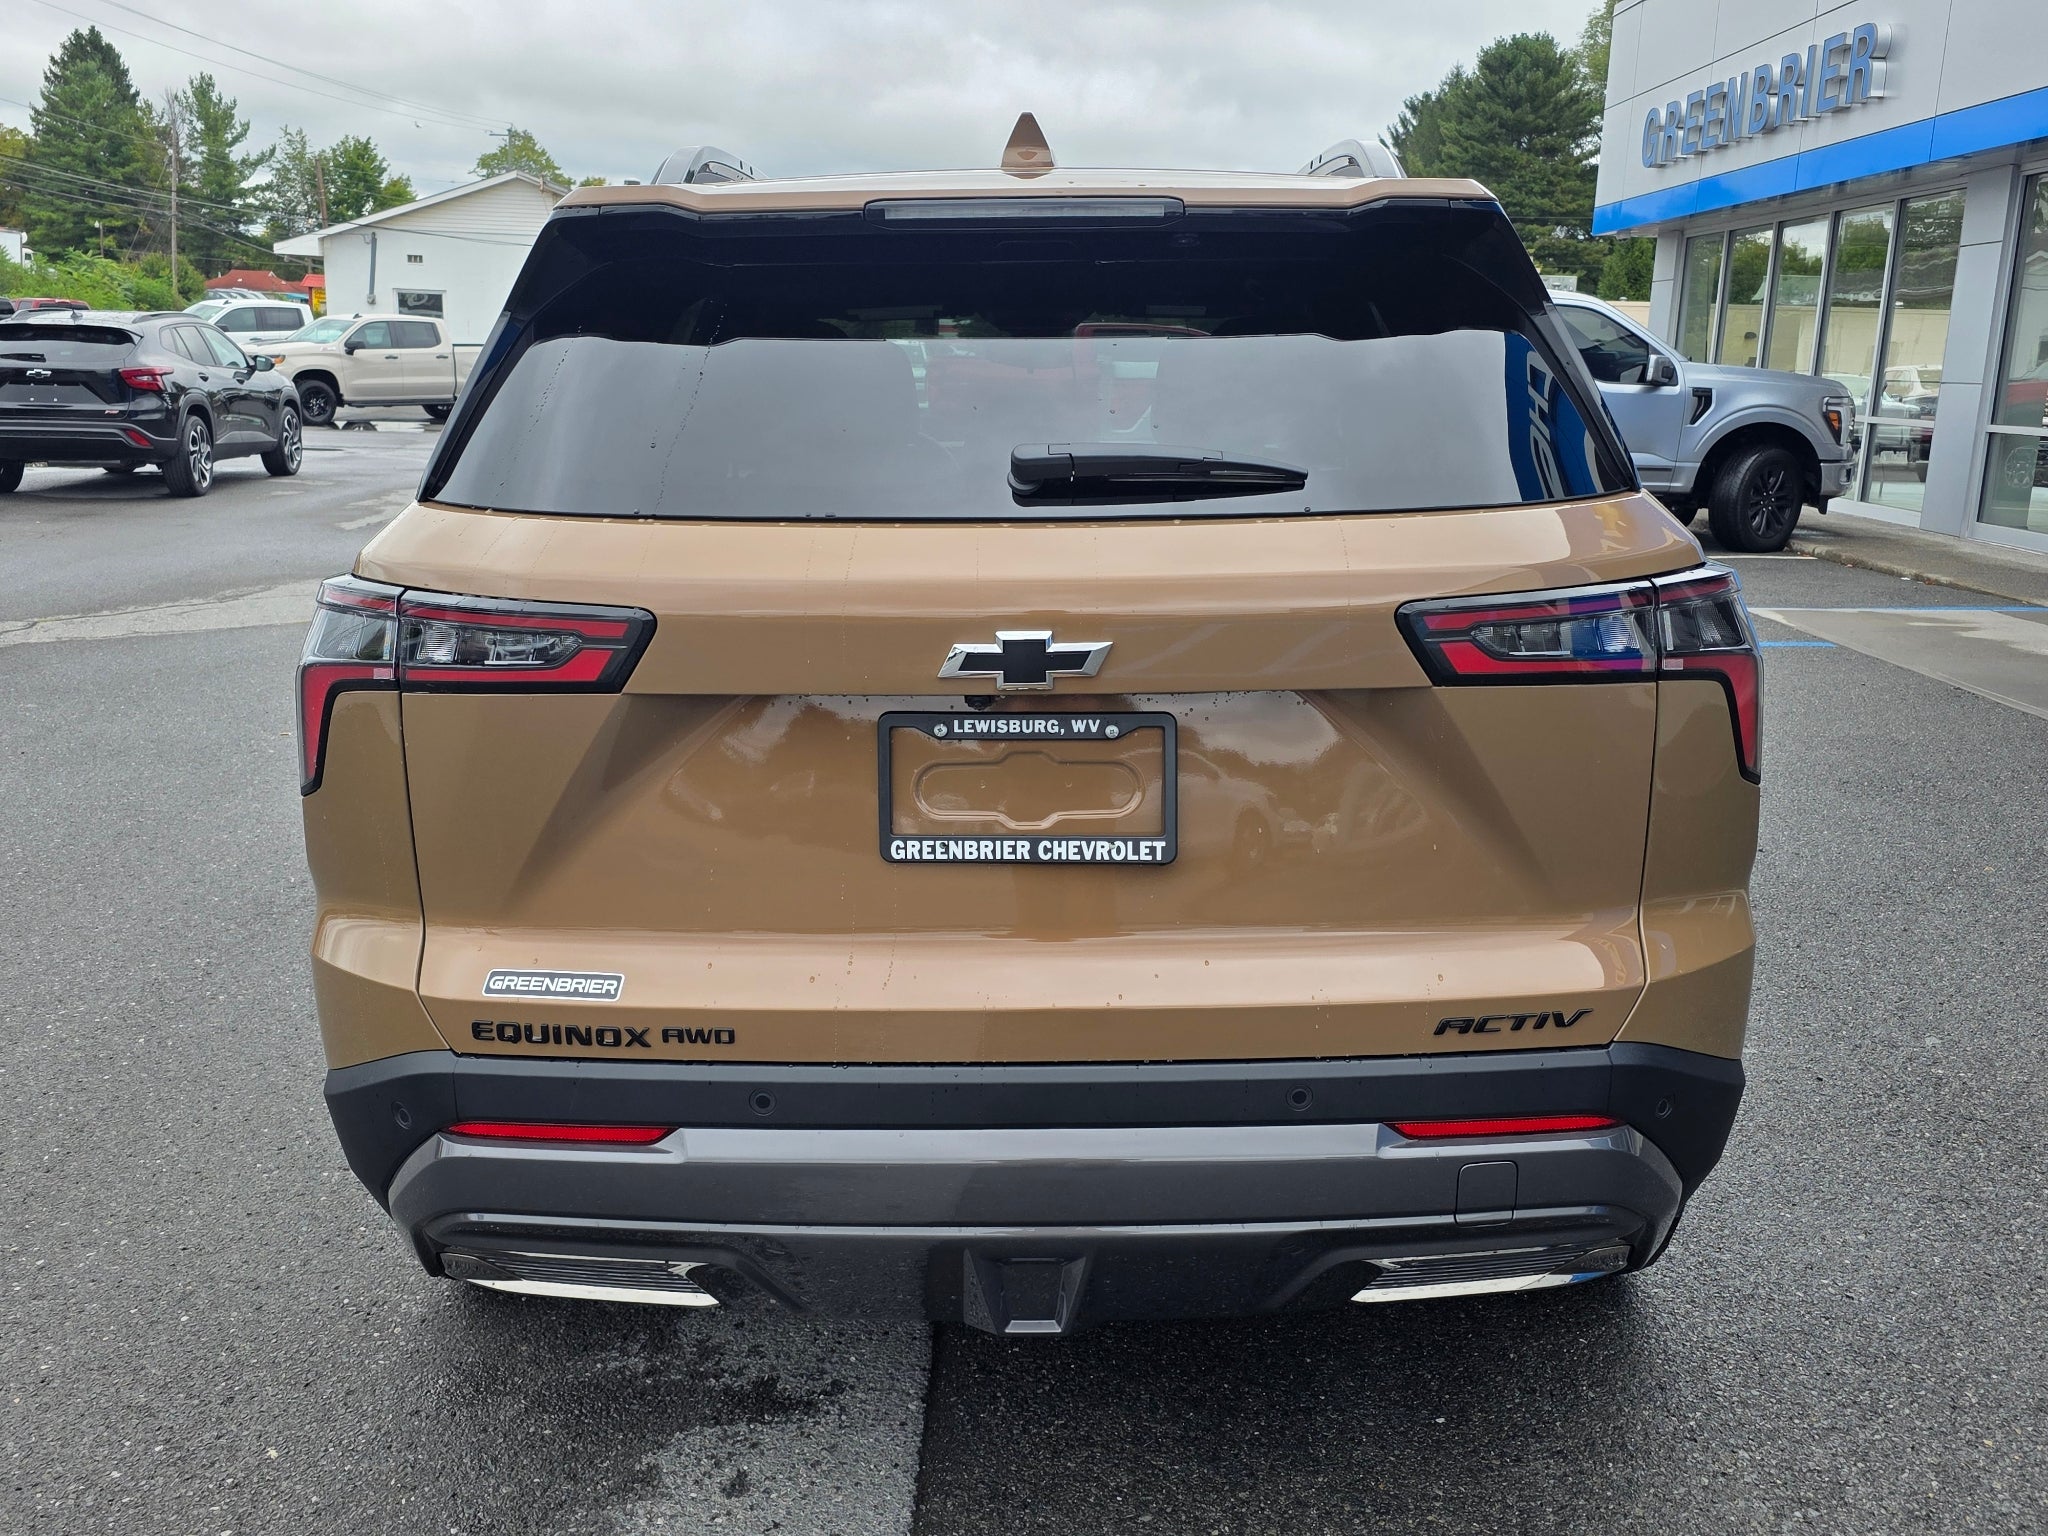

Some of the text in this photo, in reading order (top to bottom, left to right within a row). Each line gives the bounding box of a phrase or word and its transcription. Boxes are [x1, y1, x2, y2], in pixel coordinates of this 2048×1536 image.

[1641, 22, 1883, 168] GREENBRIER
[953, 719, 1101, 736] LEWISBURG, WV
[890, 840, 1167, 861] GREENBRIER CHEVROLET
[488, 975, 618, 995] GREENBRIER
[470, 1019, 736, 1048] EQUINOX AWD
[1433, 1007, 1594, 1036] ACTIV
